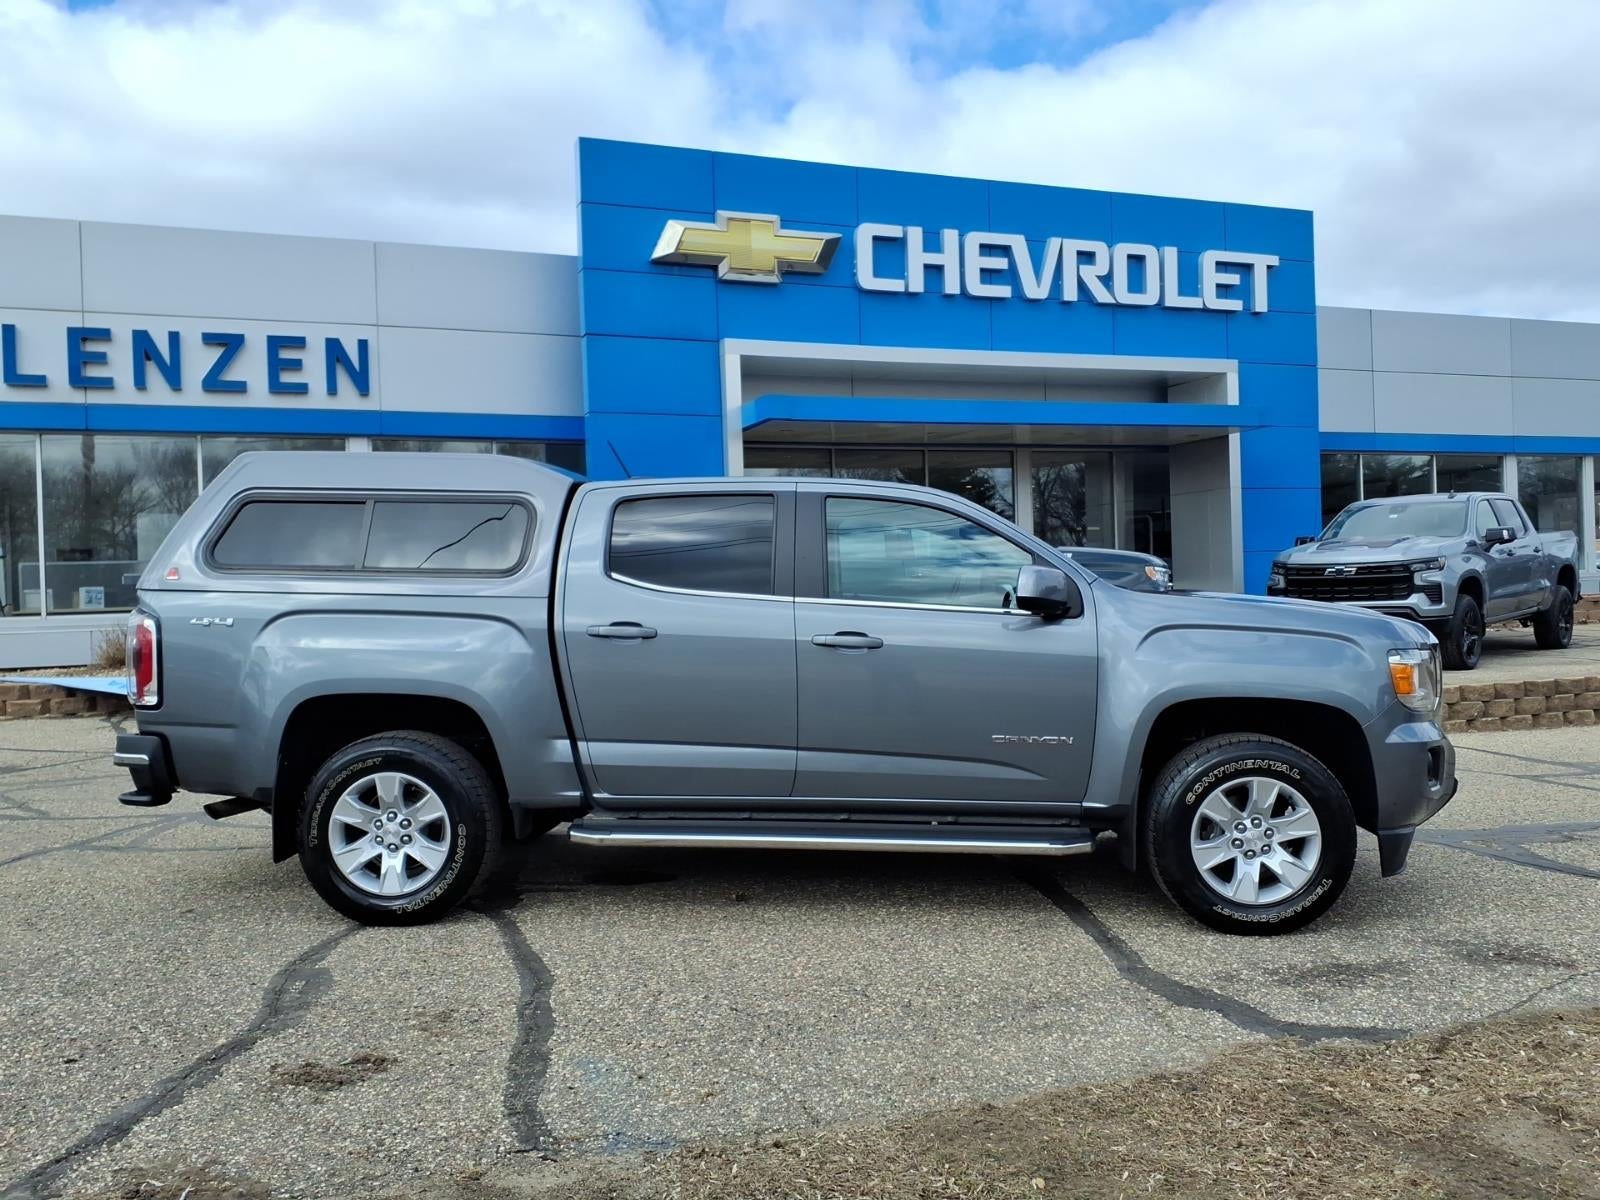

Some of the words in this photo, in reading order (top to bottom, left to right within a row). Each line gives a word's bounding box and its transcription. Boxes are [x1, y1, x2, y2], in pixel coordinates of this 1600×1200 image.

[853, 221, 1280, 314] CHEVROLET
[1, 323, 371, 396] LENZEN
[991, 735, 1074, 744] CANYON
[1185, 759, 1301, 805] CONTINENTAL
[391, 823, 467, 914] CONTINENTAL
